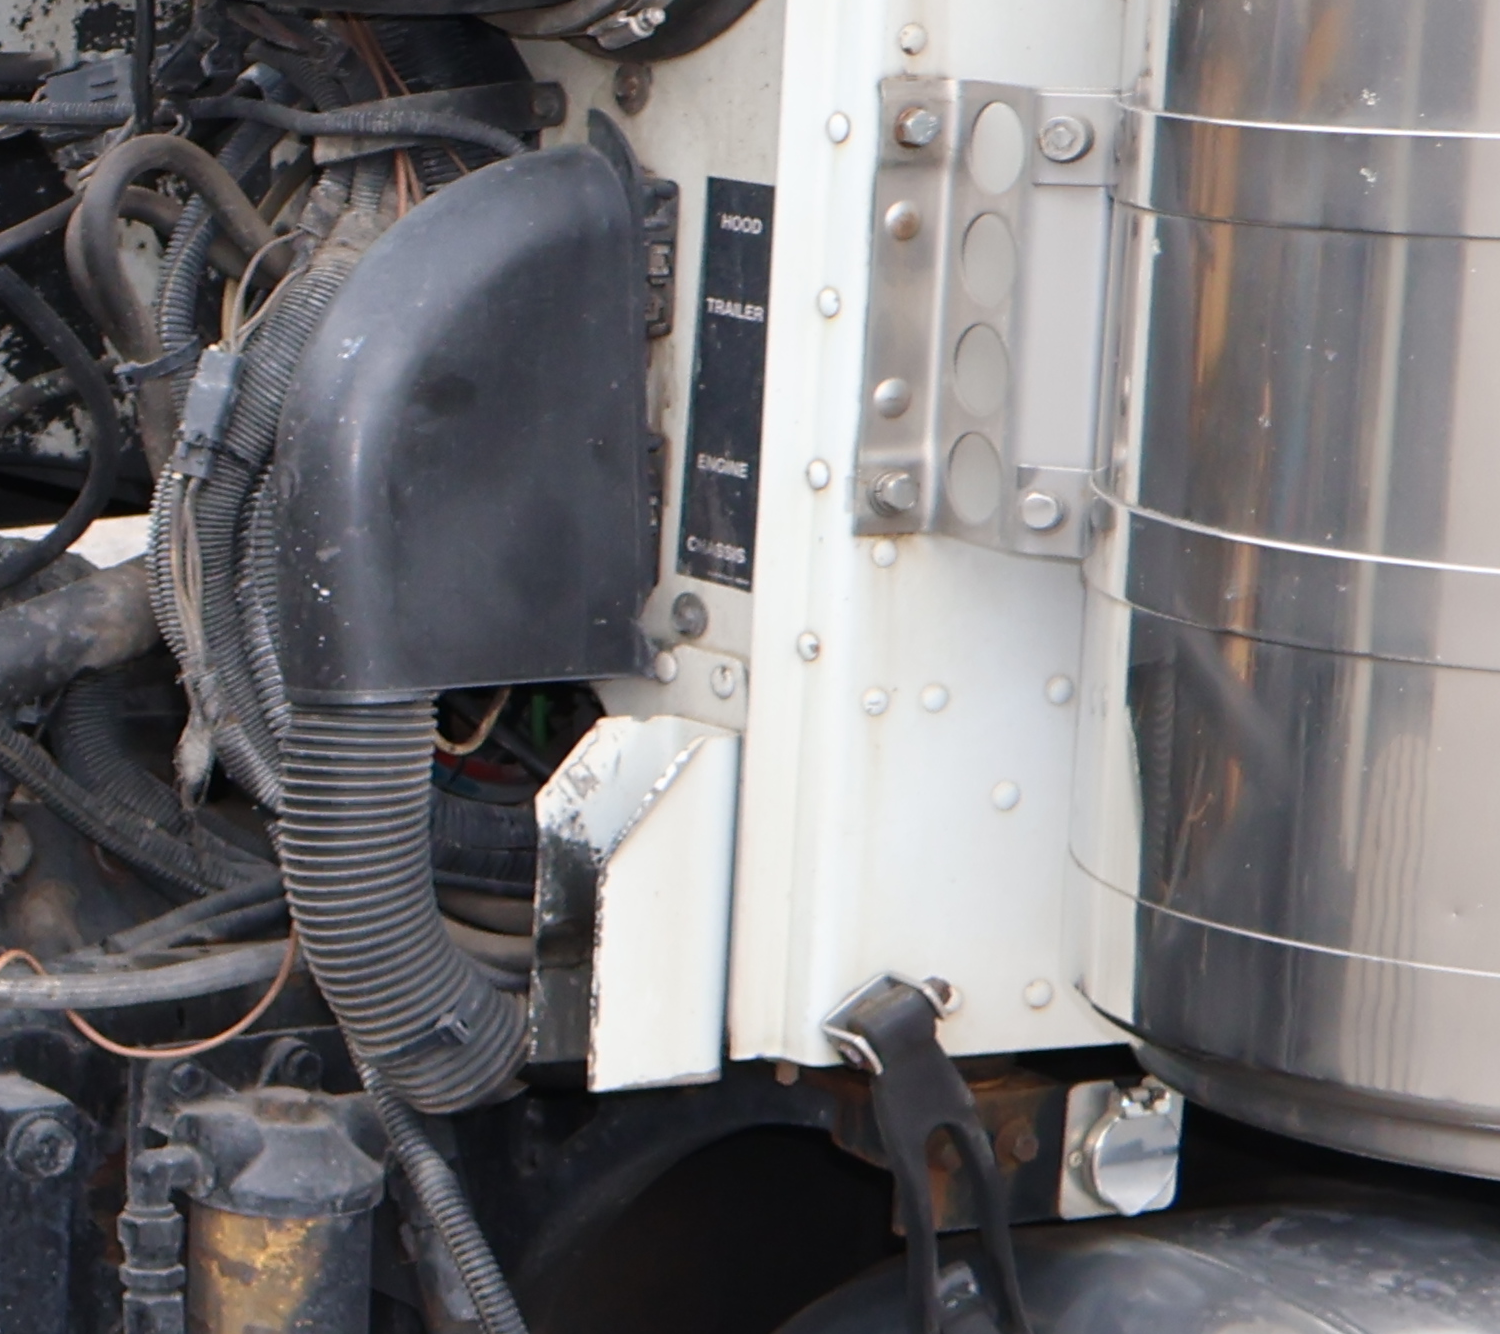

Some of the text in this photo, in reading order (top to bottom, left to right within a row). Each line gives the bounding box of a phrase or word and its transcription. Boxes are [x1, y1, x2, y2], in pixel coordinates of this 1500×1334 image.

[719, 213, 763, 236] HOOD
[706, 297, 765, 323] TRAILER
[697, 453, 749, 479] ENGINE
